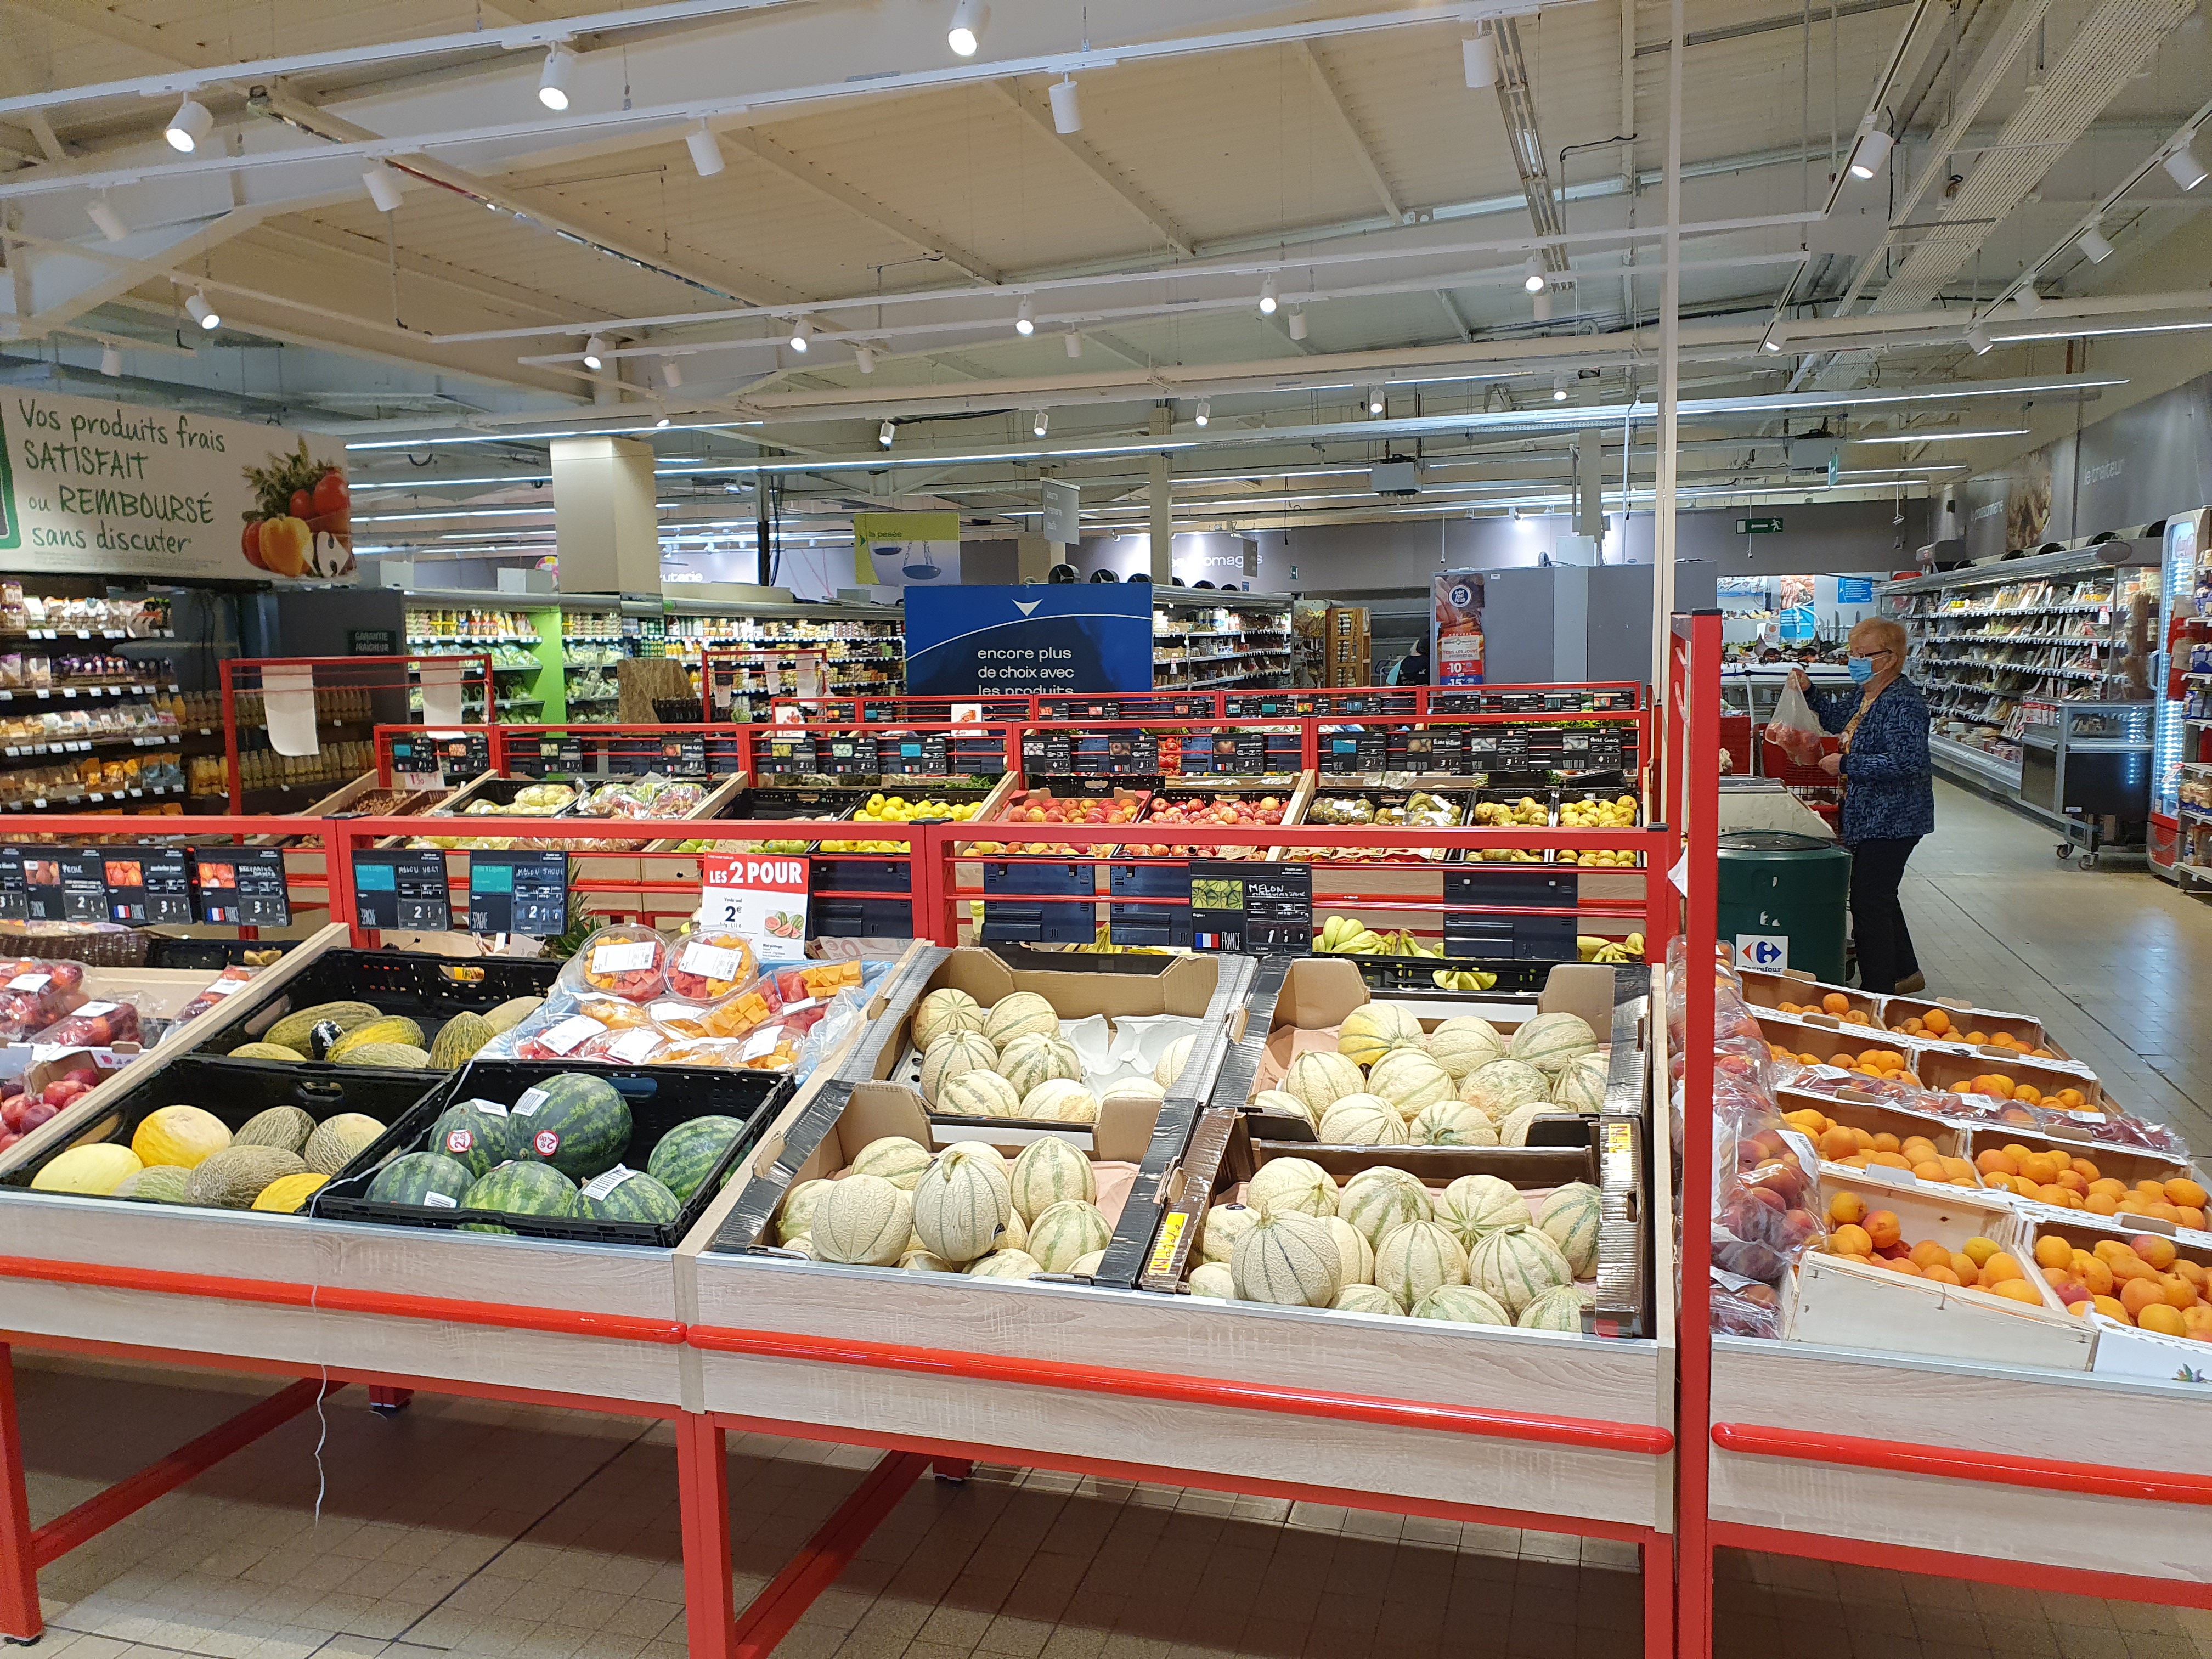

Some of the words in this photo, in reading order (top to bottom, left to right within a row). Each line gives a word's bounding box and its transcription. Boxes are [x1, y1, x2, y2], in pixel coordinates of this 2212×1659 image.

[19, 398, 61, 431] Vos
[72, 409, 168, 445] produits
[176, 415, 225, 453] frais
[24, 439, 149, 481] SATISFAIT
[29, 496, 50, 512] ou
[59, 484, 214, 524] REMBOURSÉ
[32, 526, 86, 549] sans
[96, 520, 192, 554] discuter
[978, 649, 1034, 659] encore
[1039, 646, 1072, 662] plus
[978, 665, 996, 678] de
[999, 665, 1037, 678] choix
[1040, 669, 1074, 678] avec
[978, 684, 1000, 694] les
[1005, 685, 1074, 694] produits
[709, 870, 728, 884] LES
[729, 861, 744, 884] 2
[747, 861, 803, 884] POUR
[1249, 884, 1284, 893] MELON
[78, 896, 85, 909] 2
[160, 900, 168, 913] 3
[254, 901, 261, 914] 3
[528, 905, 537, 918] 2
[1221, 932, 1241, 951] FRANCE
[1268, 929, 1274, 943] 1
